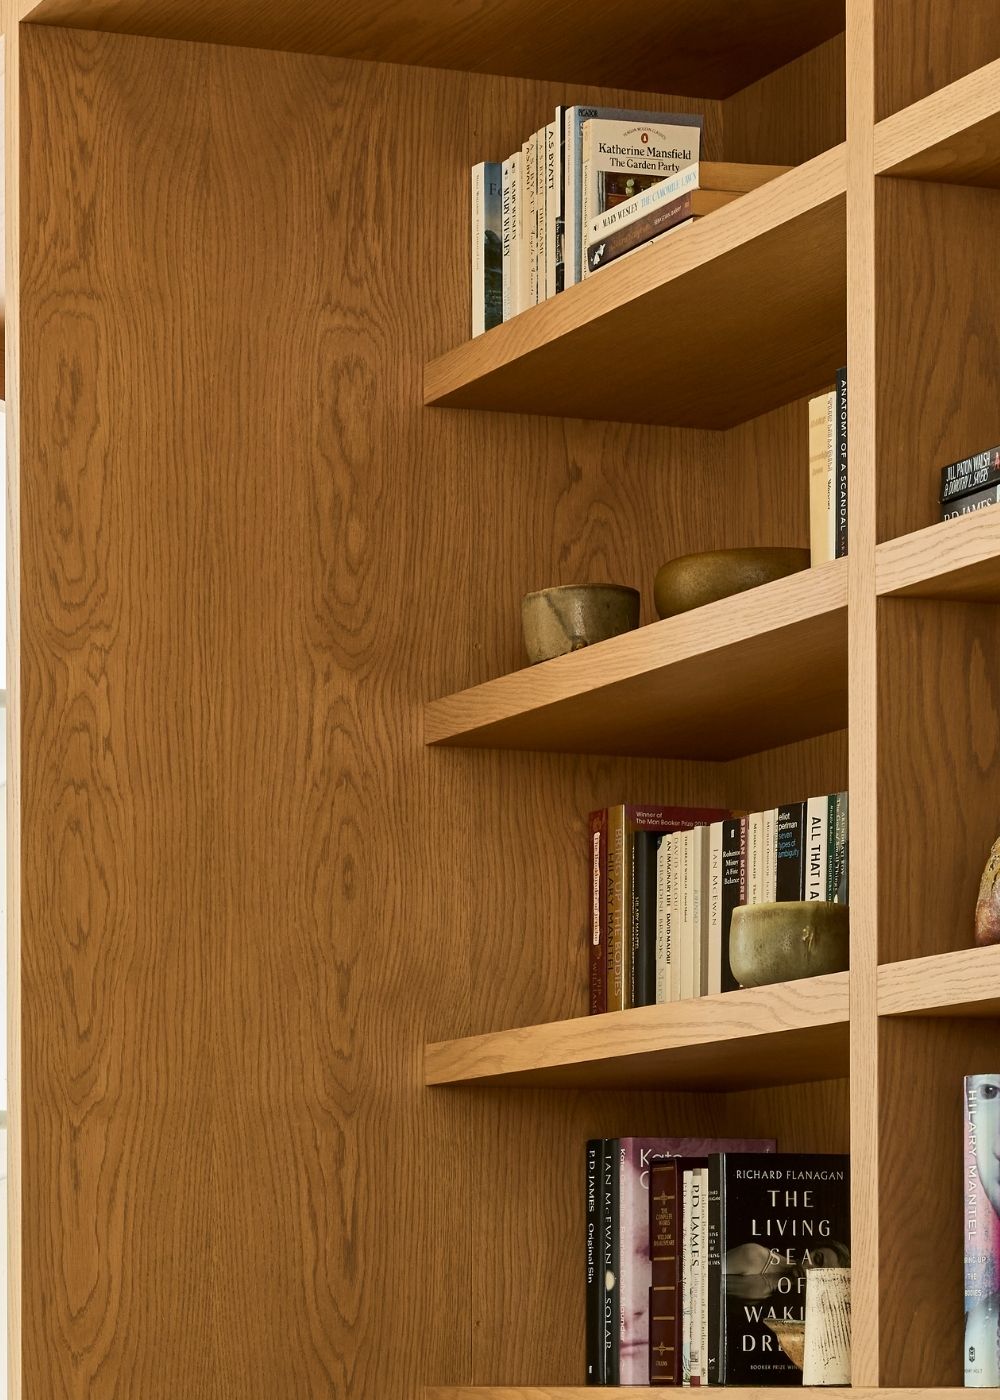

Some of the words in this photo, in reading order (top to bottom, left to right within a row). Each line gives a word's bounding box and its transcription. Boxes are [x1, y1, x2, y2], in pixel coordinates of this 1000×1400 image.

[598, 143, 645, 156] Katherine
[646, 146, 692, 160] Mansfield
[609, 157, 625, 168] The
[626, 159, 657, 171] Garden
[658, 162, 680, 174] Party
[615, 202, 640, 222] WESLEY
[840, 442, 847, 458] OF
[840, 463, 847, 474] A
[946, 465, 957, 482] JILL
[956, 457, 974, 478] PATON
[972, 451, 991, 471] WALSH
[811, 817, 822, 841] ALL
[614, 828, 622, 876] BRING
[666, 840, 672, 852] AN
[711, 849, 719, 869] IAN
[810, 845, 821, 877] THAT
[614, 880, 622, 904] UP
[614, 908, 622, 936] THE
[613, 939, 621, 997] BODIES
[967, 1090, 978, 1158] HILARY
[736, 1169, 783, 1180] RICHARD
[786, 1171, 844, 1181] FLANAGAN
[588, 1175, 596, 1212] JAMES
[767, 1190, 815, 1208] THE
[967, 1165, 978, 1241] MANTEL
[751, 1219, 831, 1237] LIVING
[587, 1223, 595, 1264] Original
[692, 1216, 700, 1267] JAMES
[769, 1248, 814, 1266] SEA
[777, 1276, 805, 1294] OF
[604, 1297, 612, 1350] SOLAR
[743, 1306, 805, 1323] WAKI
